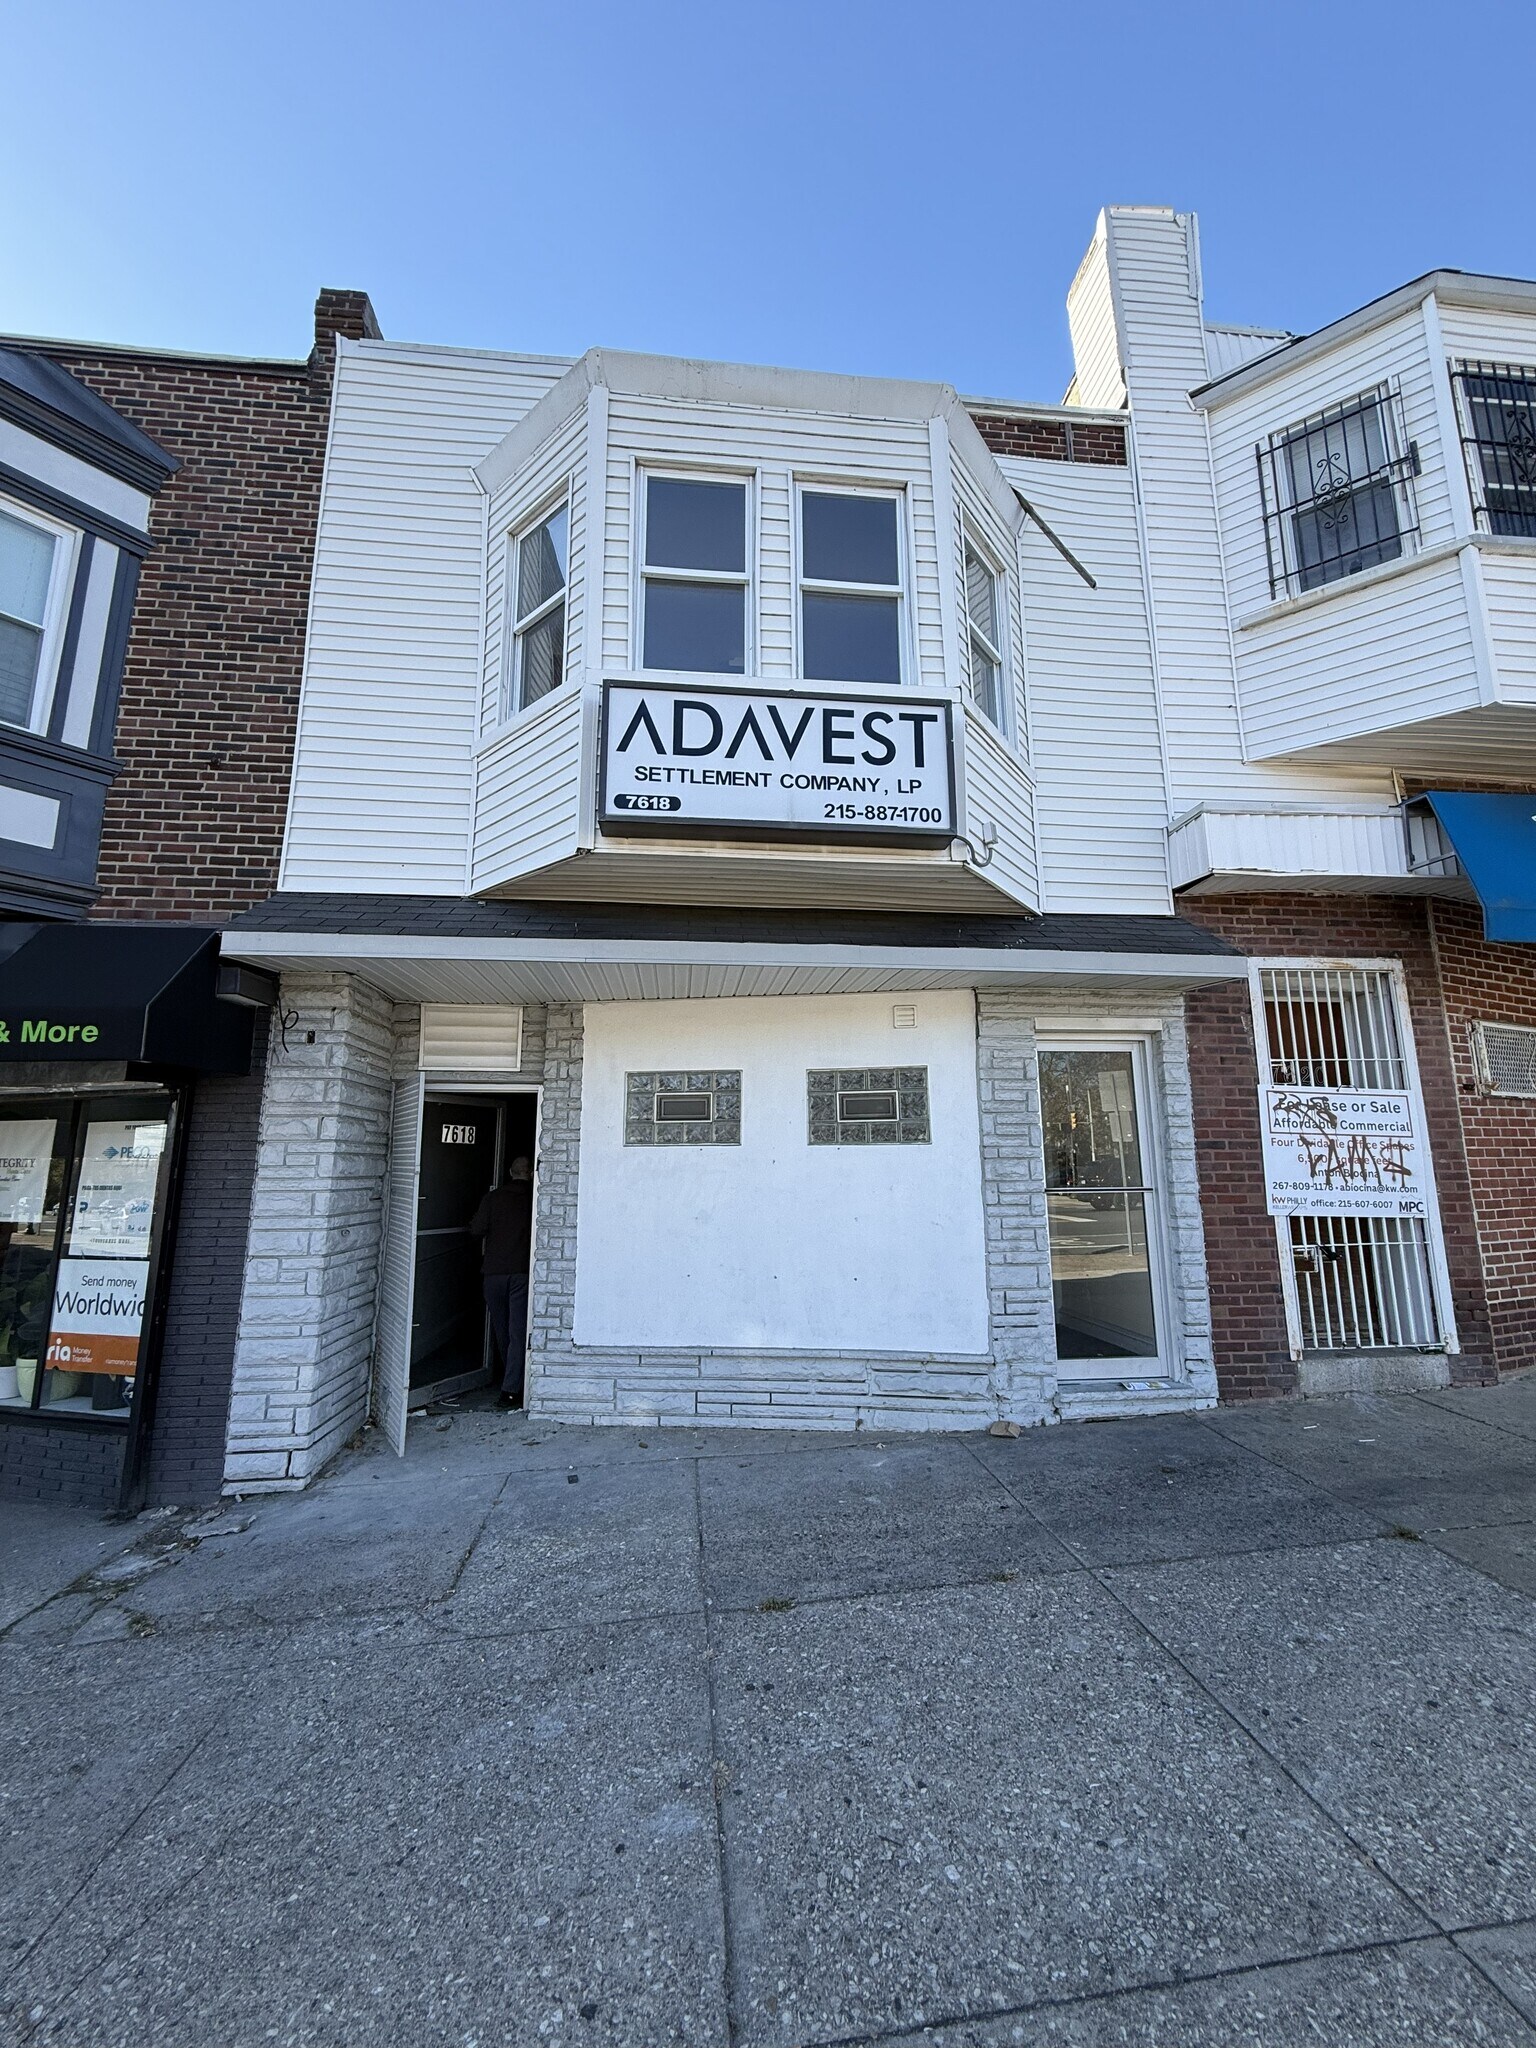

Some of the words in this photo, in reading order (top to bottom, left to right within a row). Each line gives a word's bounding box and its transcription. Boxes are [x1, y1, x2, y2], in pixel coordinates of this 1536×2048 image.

[615, 698, 938, 768] ADAVEST
[634, 765, 772, 788] SETTLEMENT
[897, 778, 922, 794] LP
[625, 795, 671, 810] 7618
[823, 803, 942, 823] 215-887-1700
[20, 1020, 99, 1043] More
[1351, 1102, 1366, 1113] or
[1370, 1100, 1401, 1114] Sale
[443, 1125, 475, 1143] 7618
[1340, 1119, 1411, 1132] Commercial
[1270, 1137, 1295, 1147] Four
[1272, 1181, 1334, 1191] 267-809-1178
[1339, 1182, 1419, 1194] abiocina@kw.com
[1286, 1196, 1308, 1205] PHILLY
[1310, 1198, 1337, 1207] office:
[1337, 1199, 1393, 1209] 215-607-6007
[1398, 1201, 1425, 1213] MPC
[81, 1274, 105, 1287] Send
[106, 1279, 138, 1290] money
[46, 1337, 72, 1362] ria
[72, 1346, 92, 1356] Money
